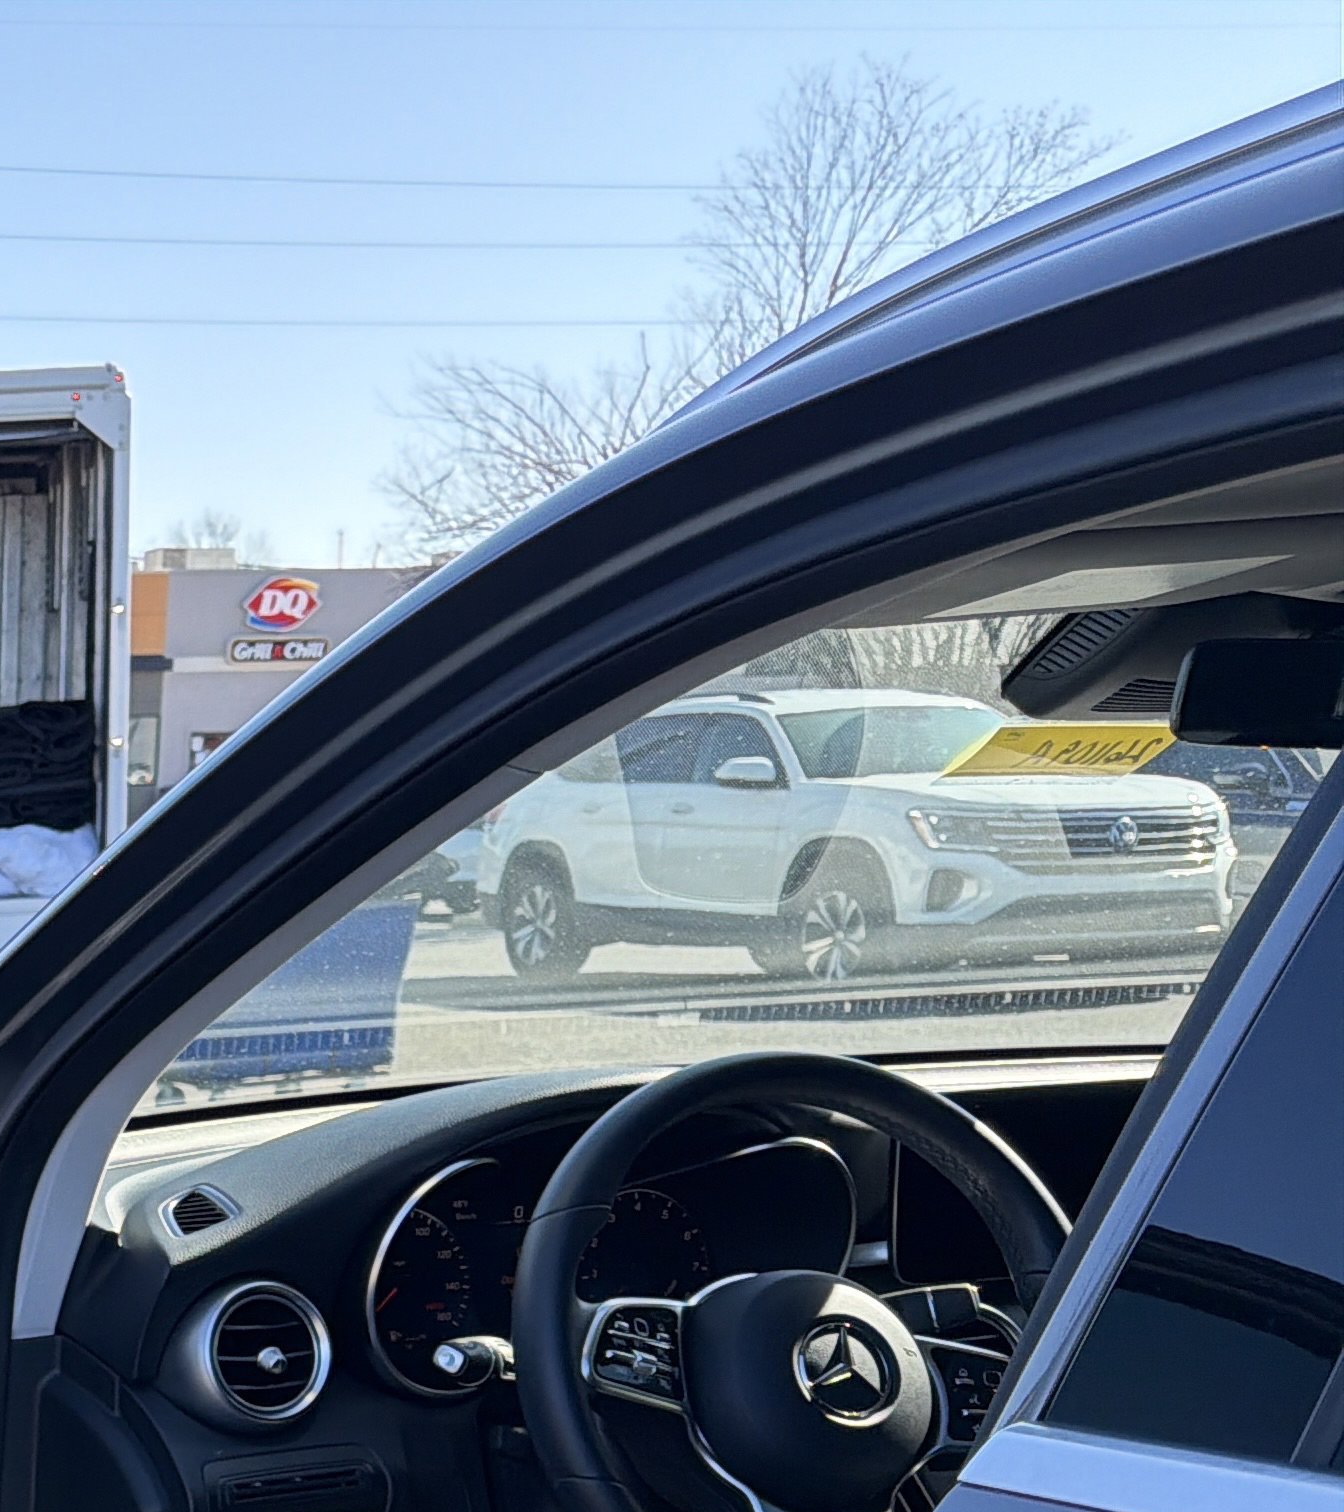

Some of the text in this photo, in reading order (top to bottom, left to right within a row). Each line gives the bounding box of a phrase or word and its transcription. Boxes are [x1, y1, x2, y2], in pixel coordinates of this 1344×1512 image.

[258, 588, 309, 619] DQ
[234, 642, 273, 660] Grill
[283, 642, 325, 659] Chill
[514, 1205, 524, 1219] 0
